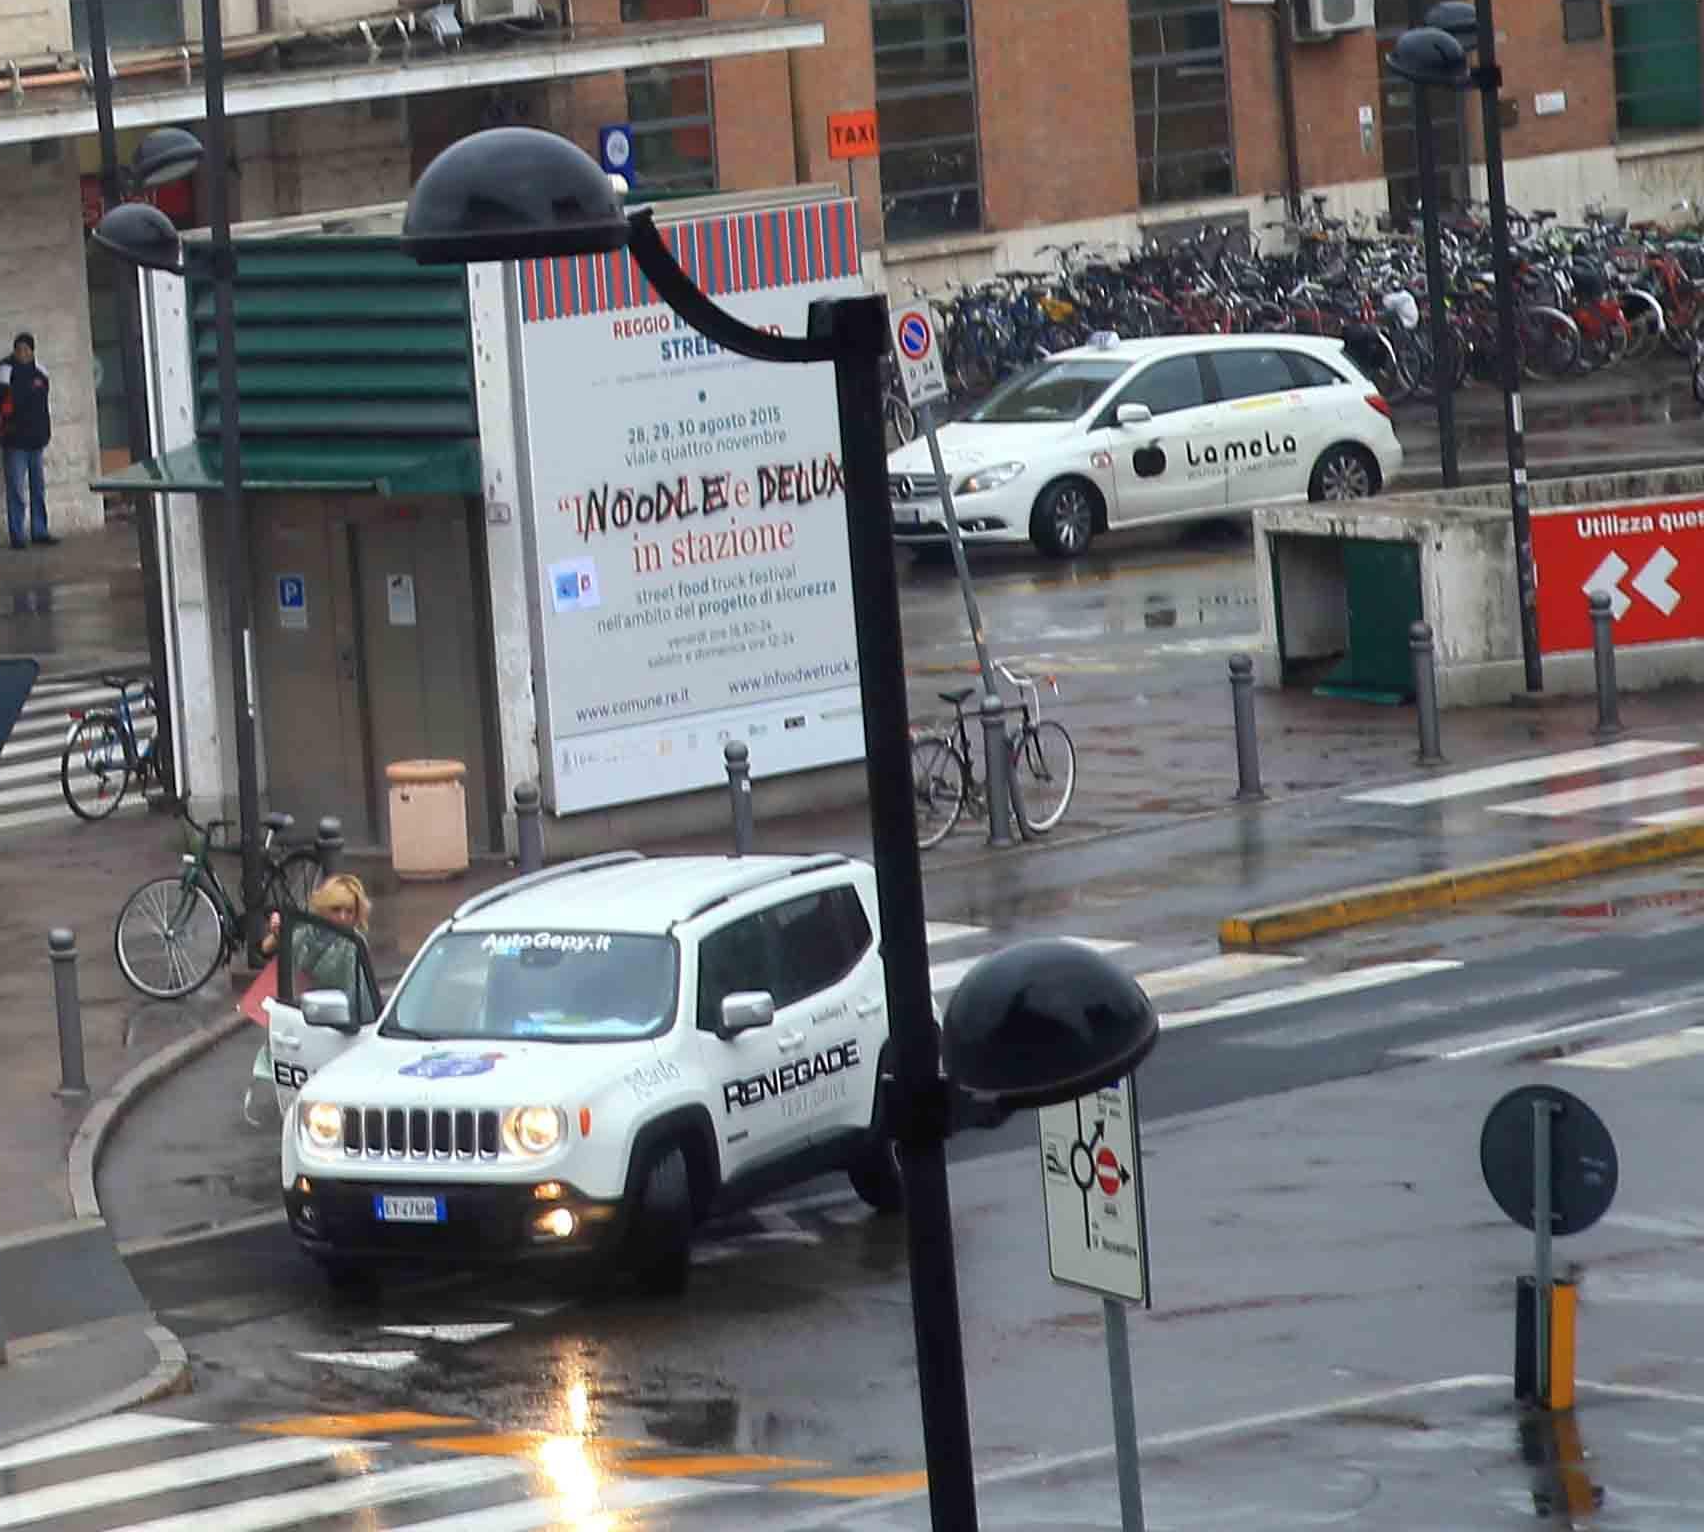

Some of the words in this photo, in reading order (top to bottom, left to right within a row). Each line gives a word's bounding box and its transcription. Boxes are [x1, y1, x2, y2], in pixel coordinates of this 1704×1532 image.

[832, 124, 874, 145] TAXI
[613, 315, 670, 340] REGGIO
[677, 420, 694, 438] 30
[699, 413, 747, 439] agosto
[750, 406, 781, 423] 2015
[625, 444, 657, 467] viale
[662, 440, 712, 466] quattro
[717, 428, 786, 453] novembre
[1577, 512, 1654, 539] Utilizza
[633, 532, 662, 572] in
[671, 518, 794, 568] stazione
[636, 585, 675, 606] street
[678, 580, 709, 599] food
[712, 572, 745, 595] truck
[748, 564, 797, 585] festival
[675, 600, 695, 621] del
[699, 589, 756, 618] progetto
[760, 589, 773, 606] di
[776, 578, 837, 602] sicurezza
[576, 688, 690, 723] www.comune.re.it
[480, 932, 613, 955] AutoGepy.it
[274, 1059, 318, 1090] EG
[722, 1038, 863, 1115] RENEGADE
